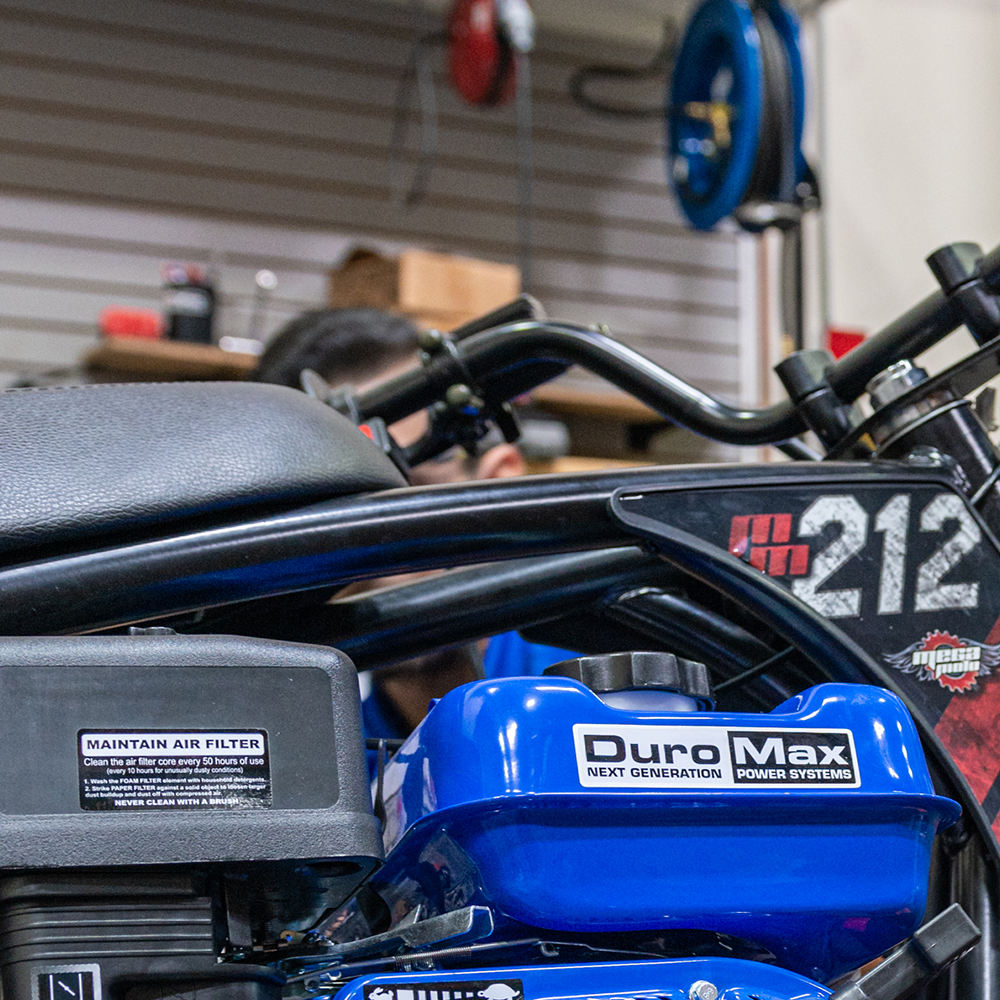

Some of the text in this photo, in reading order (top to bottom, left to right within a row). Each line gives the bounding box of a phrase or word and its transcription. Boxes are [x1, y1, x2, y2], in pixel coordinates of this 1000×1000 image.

[791, 493, 982, 620] 212
[87, 739, 260, 750] MAINTAIN AIR FILTER
[83, 757, 109, 767] Clean
[110, 757, 124, 766] the
[125, 757, 137, 766] air
[138, 757, 157, 766] filter
[158, 758, 177, 766] core
[178, 758, 201, 767] every
[202, 756, 213, 765] 50
[214, 756, 238, 765] hours
[239, 756, 248, 765] of
[587, 767, 722, 779] NEXT GENERATION
[736, 768, 852, 781] POWER SYSTEMS
